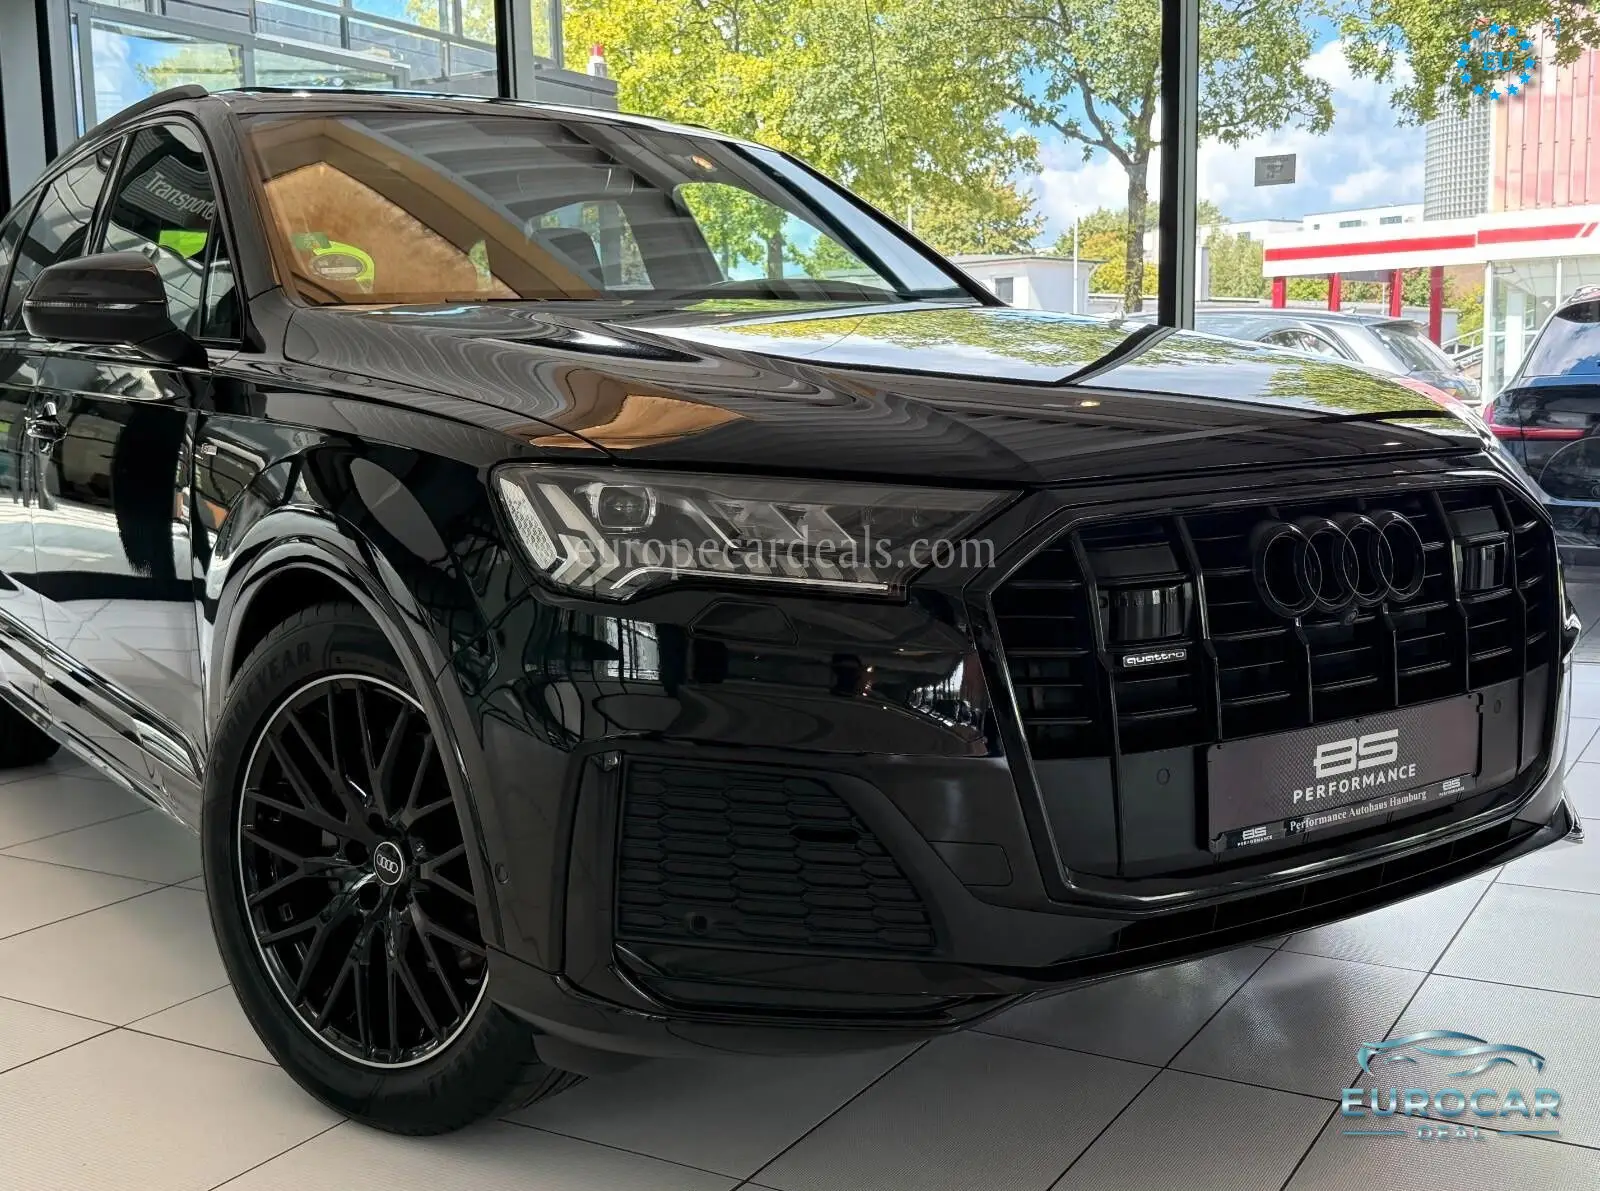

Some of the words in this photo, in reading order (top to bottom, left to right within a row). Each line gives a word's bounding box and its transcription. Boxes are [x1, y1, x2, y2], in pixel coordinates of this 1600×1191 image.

[1126, 651, 1185, 665] quattro
[1293, 763, 1417, 804] PERFORMANCE
[1290, 810, 1347, 831] Performance
[1349, 801, 1388, 817] Autohaus
[1390, 790, 1427, 807] Hamburg
